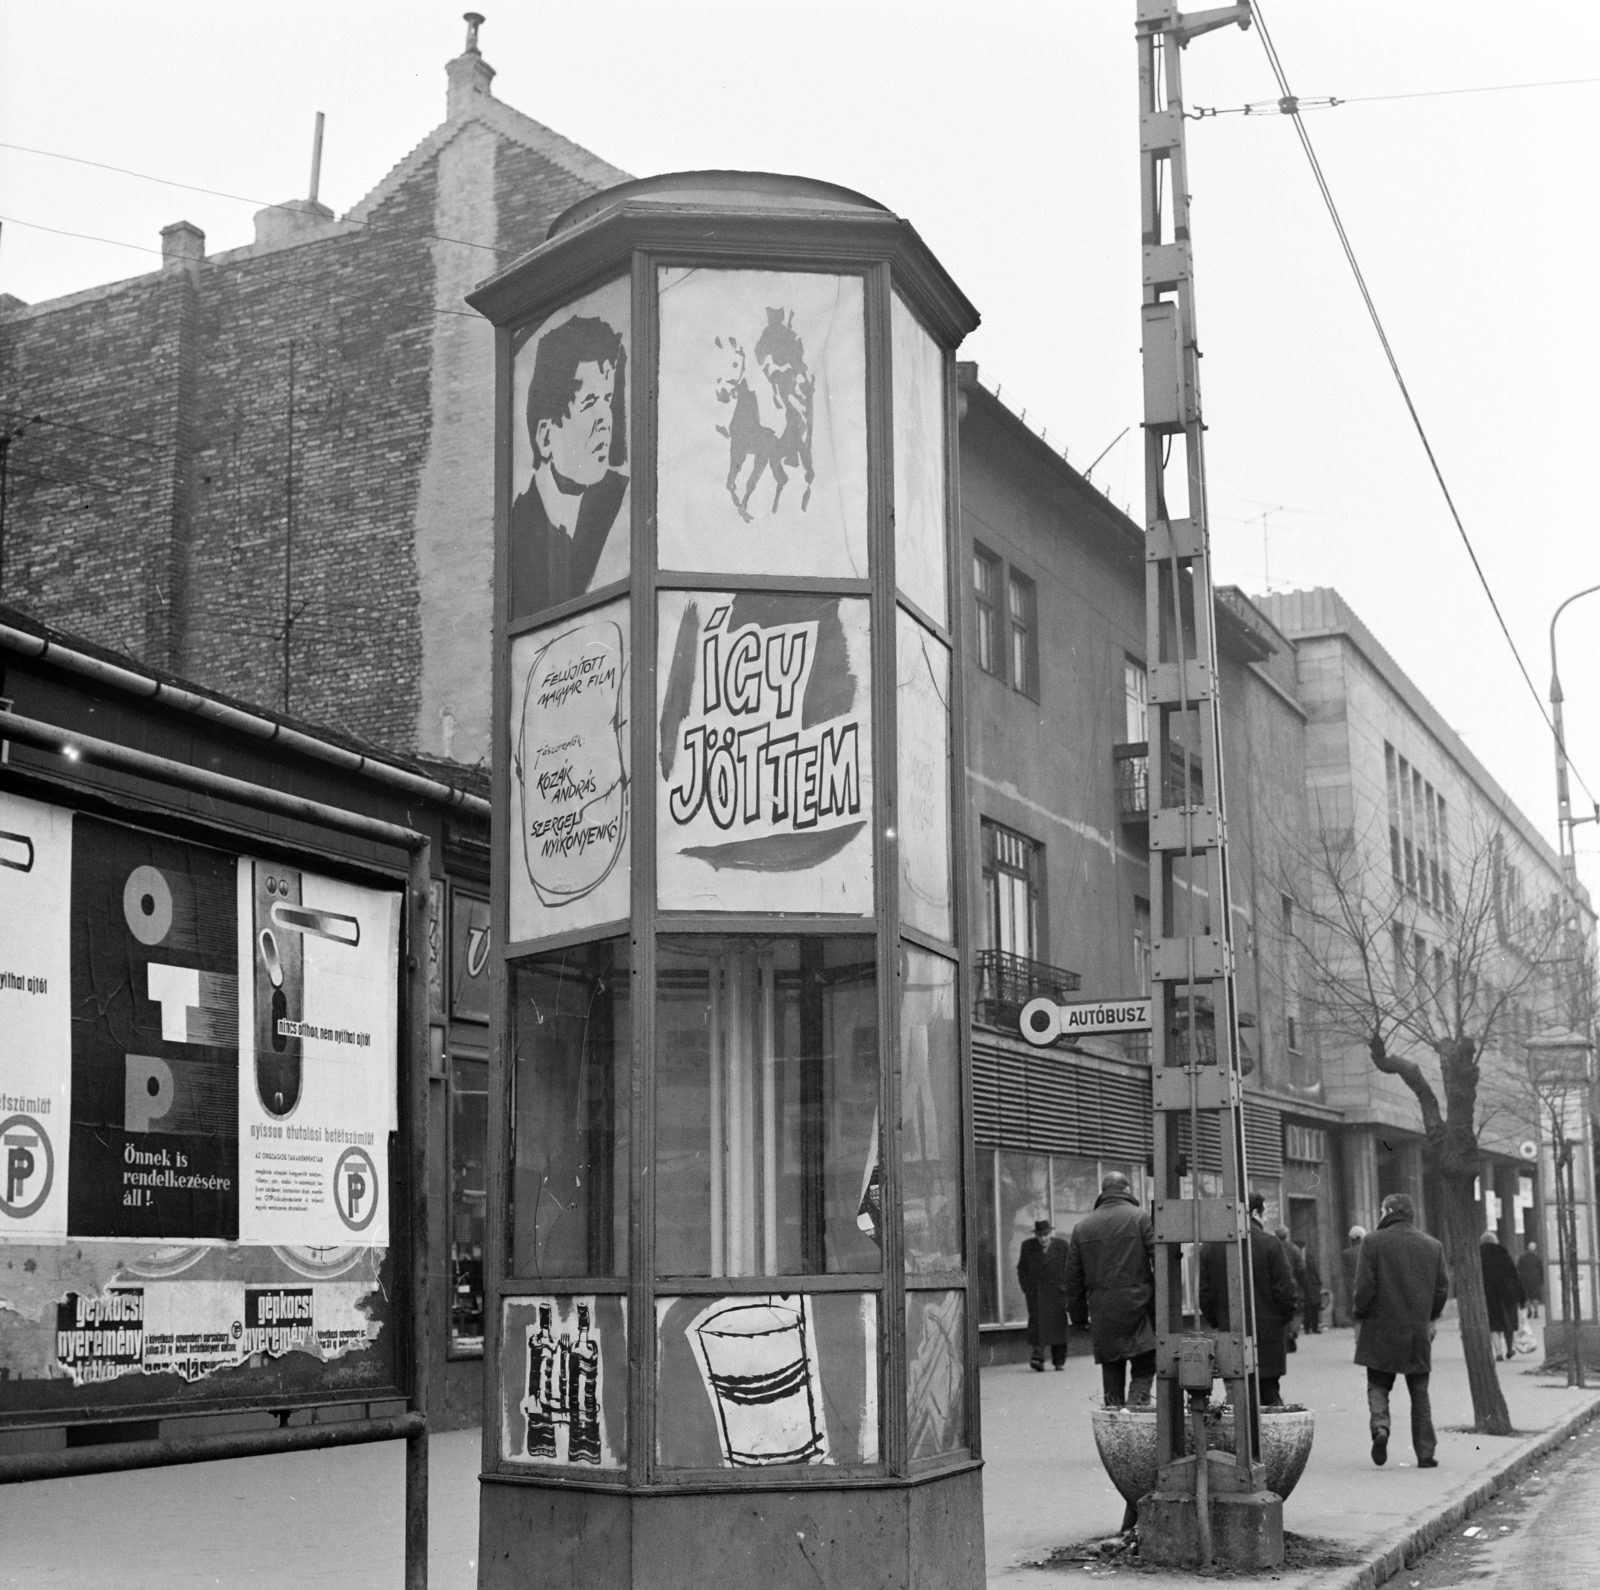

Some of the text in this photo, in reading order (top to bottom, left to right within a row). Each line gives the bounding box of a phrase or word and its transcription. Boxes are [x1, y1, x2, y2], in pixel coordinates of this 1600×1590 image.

[536, 667, 616, 709] MAGYAR FILM
[536, 758, 573, 800] KOZÁK
[550, 769, 596, 804] ANDRÁS
[669, 722, 861, 831] JÖTTEM
[27, 975, 48, 995] ajtót
[1068, 1004, 1146, 1026] AUTÓBUSZ
[278, 1019, 297, 1035] nincs
[320, 1028, 333, 1041] nem
[334, 1029, 356, 1044] nyithat
[356, 1031, 371, 1048] ajtót
[250, 1122, 375, 1146] nyisson átutalási betétszámlát
[124, 1142, 189, 1168] Önnek is
[123, 1169, 231, 1191] rendelkezésére
[123, 1189, 142, 1206] áll
[57, 1326, 144, 1363] nyeremény
